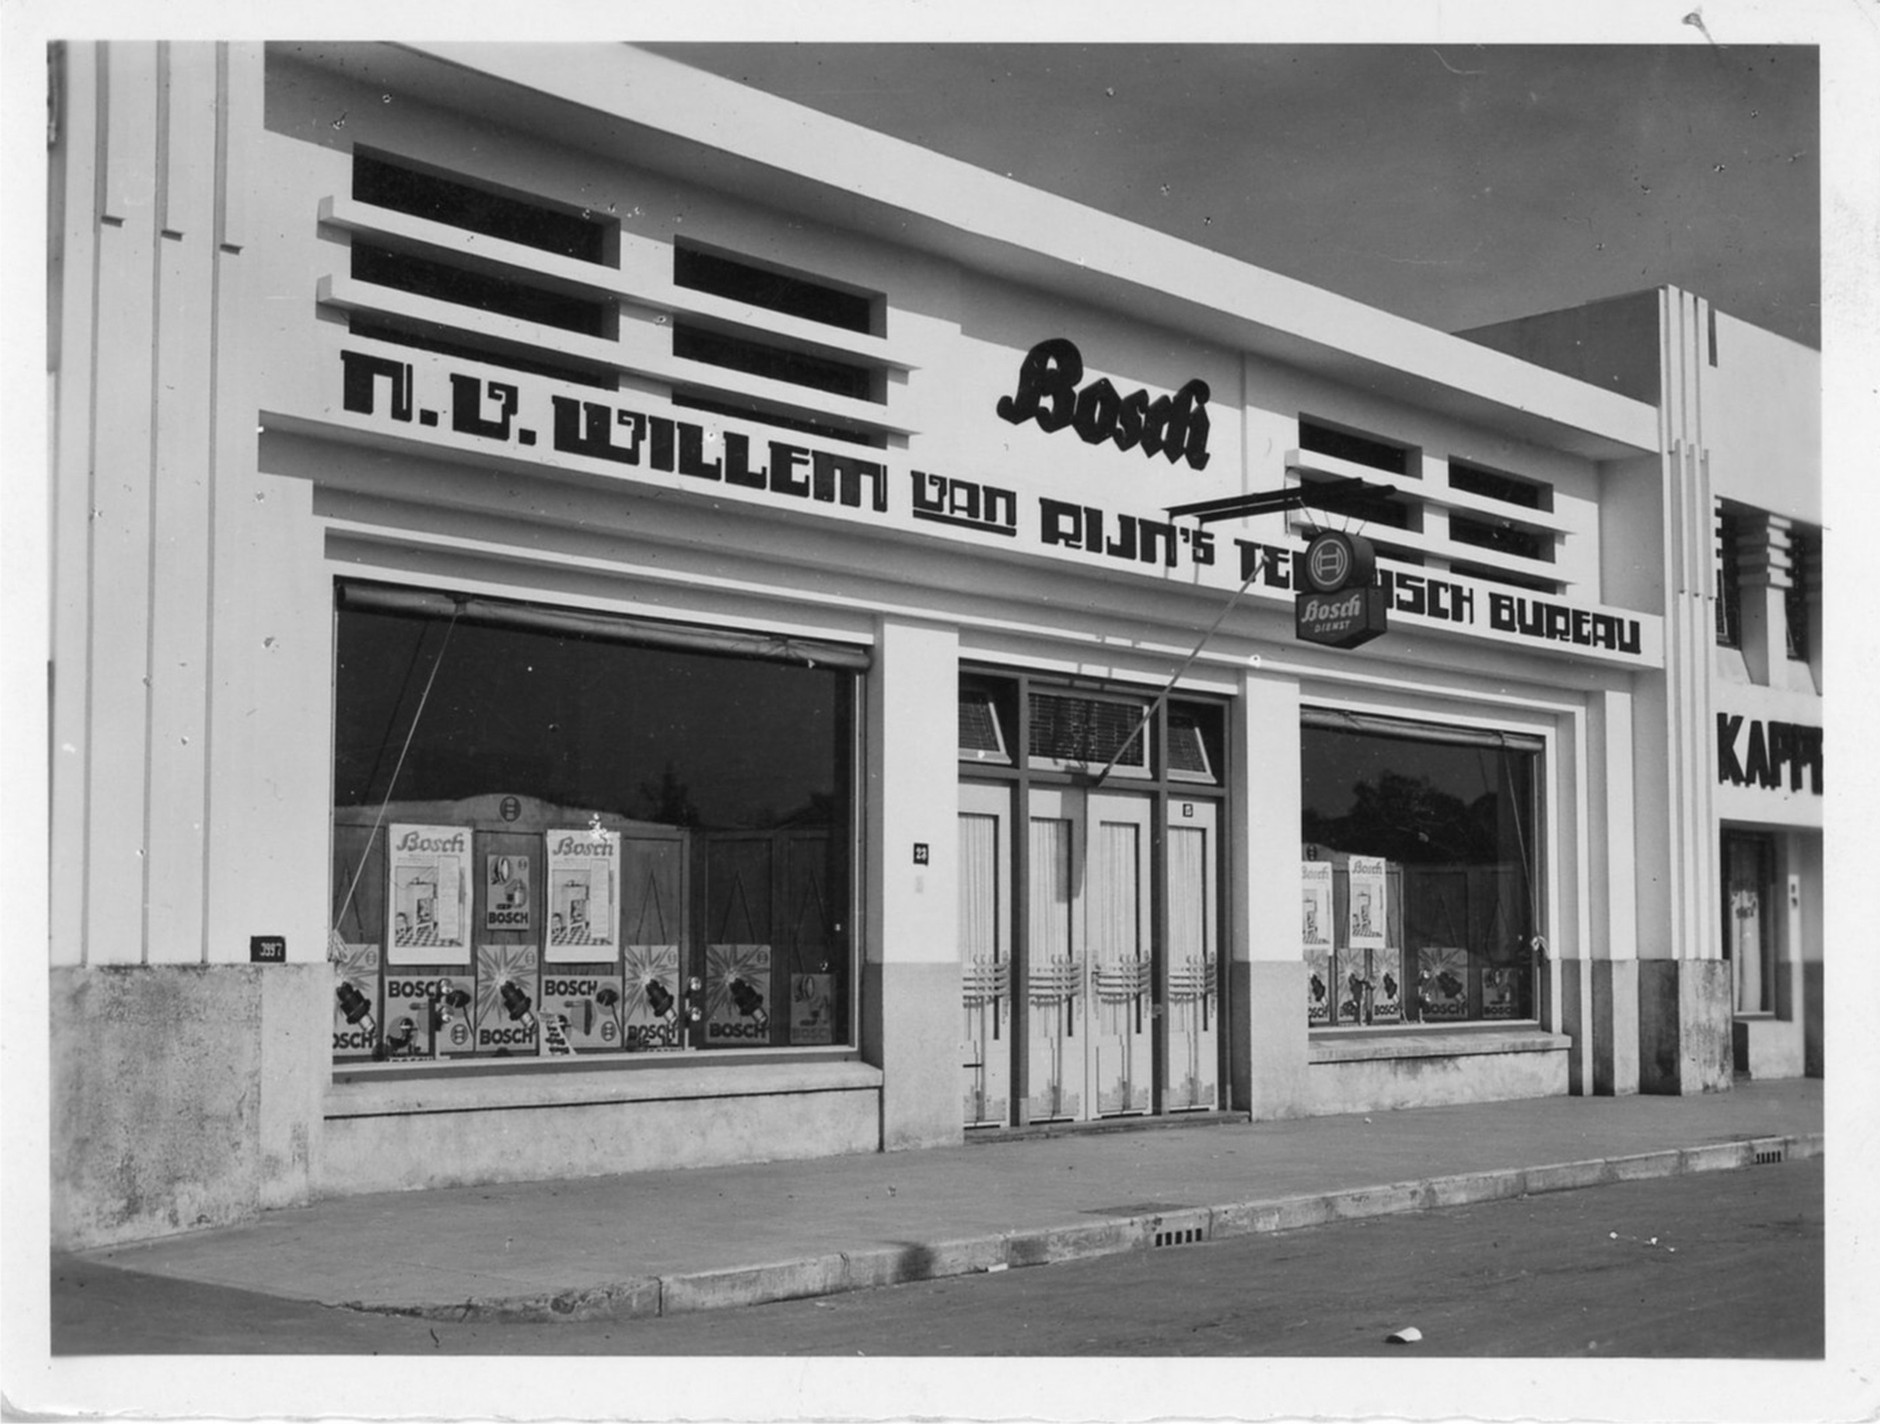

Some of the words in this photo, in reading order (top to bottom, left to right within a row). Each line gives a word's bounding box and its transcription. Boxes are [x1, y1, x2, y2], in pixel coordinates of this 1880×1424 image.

[997, 338, 1211, 471] Bosch
[552, 395, 888, 513] WILLEM
[910, 470, 1017, 528] VAN
[1038, 496, 1215, 568] RIJN'S
[1233, 537, 1475, 626] TEISCH
[1488, 591, 1642, 655] BUREAU
[1301, 594, 1361, 623] Bosch
[1314, 620, 1351, 633] DIENST
[396, 830, 464, 853] Bosch
[552, 834, 614, 857] Bosch
[1352, 859, 1383, 876] Bosch
[488, 911, 529, 924] BOSCH
[544, 980, 598, 996] BOSCH
[479, 1027, 534, 1045] BOSCH
[709, 1023, 767, 1038] BOSCH
[332, 1031, 373, 1049] OSCH
